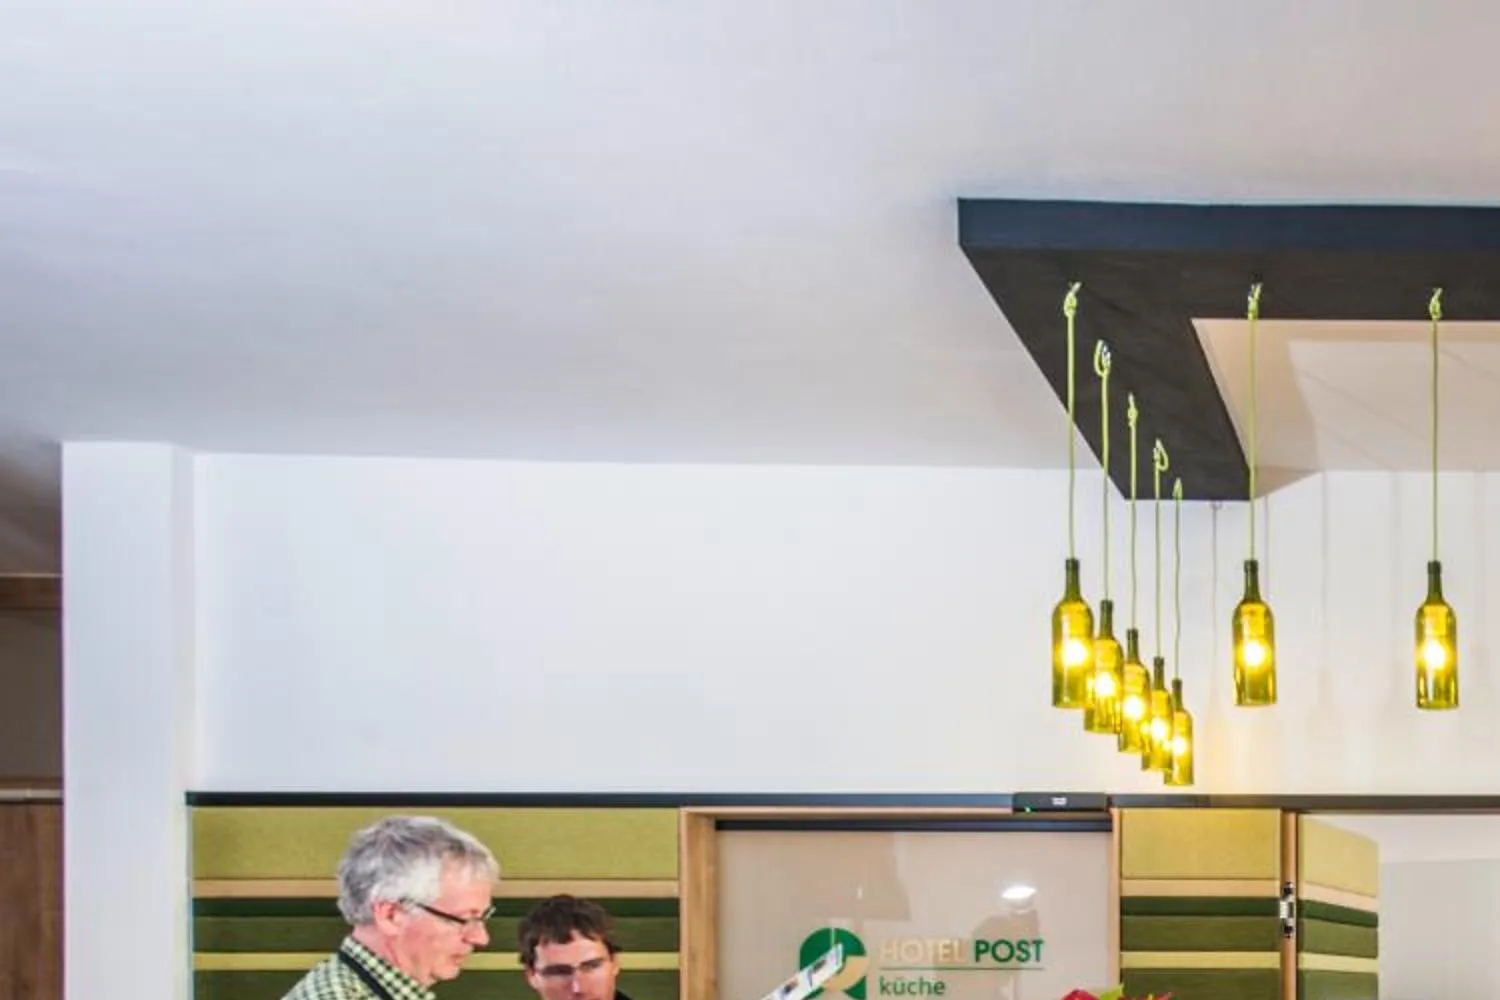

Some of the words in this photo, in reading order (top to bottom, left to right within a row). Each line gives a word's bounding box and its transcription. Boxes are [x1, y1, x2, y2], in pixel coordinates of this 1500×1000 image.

[880, 940, 967, 963] HOTEL
[975, 939, 1044, 963] POST
[879, 976, 946, 995] küche
